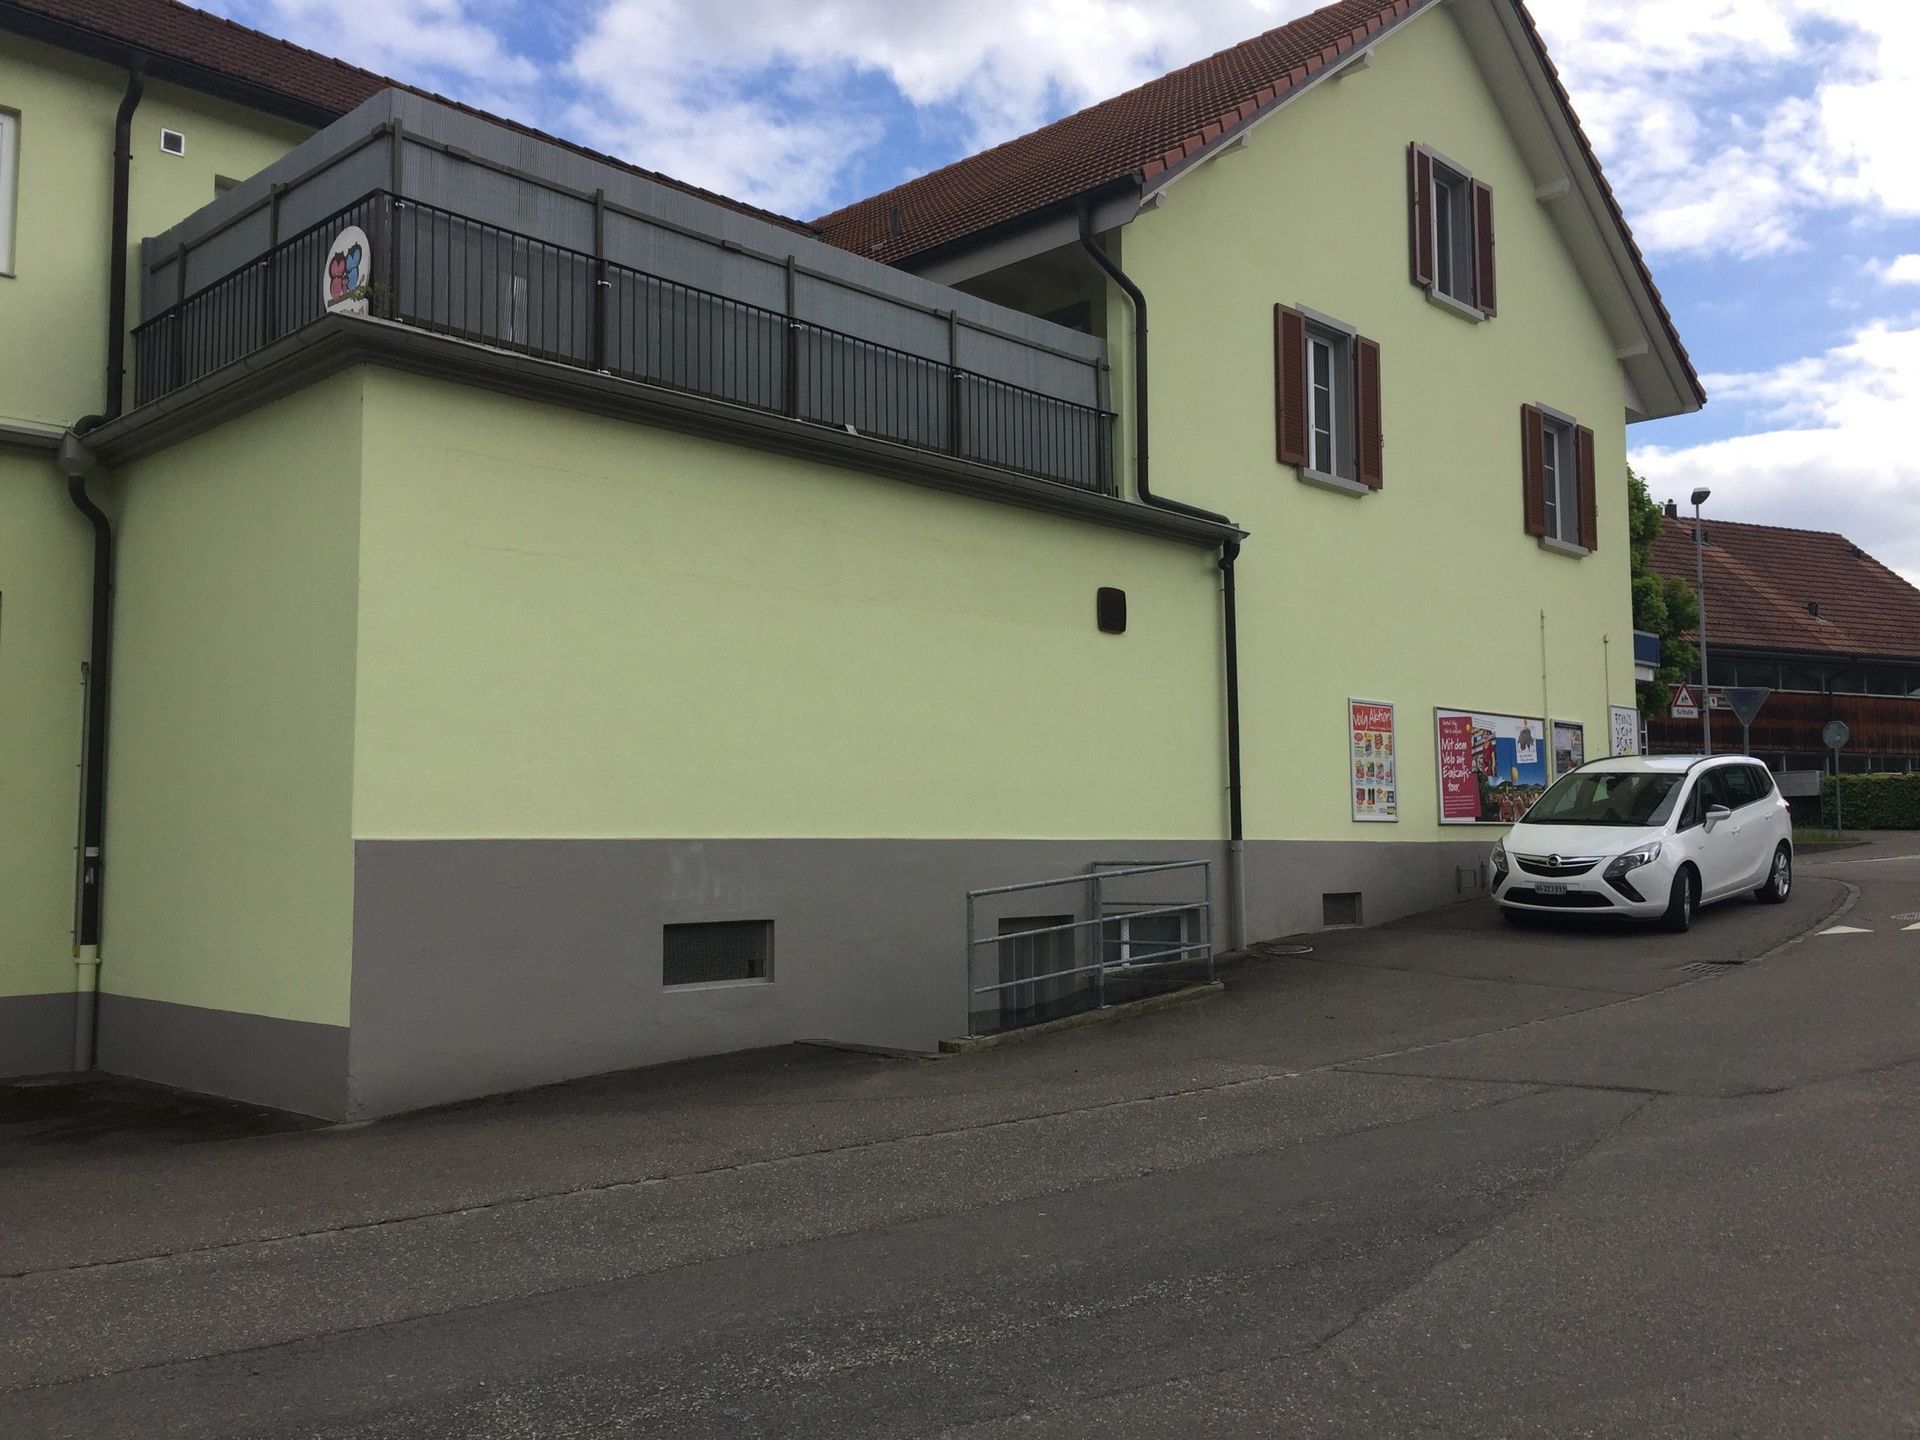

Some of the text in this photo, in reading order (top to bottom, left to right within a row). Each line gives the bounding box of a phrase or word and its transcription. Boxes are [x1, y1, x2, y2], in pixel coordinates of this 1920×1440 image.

[1352, 708, 1392, 730] Volg Aktion
[1676, 708, 1694, 716] Schule
[1441, 737, 1468, 750] Mit dem
[1442, 751, 1465, 767] Velo auf
[1442, 765, 1472, 782] Einkaufs-
